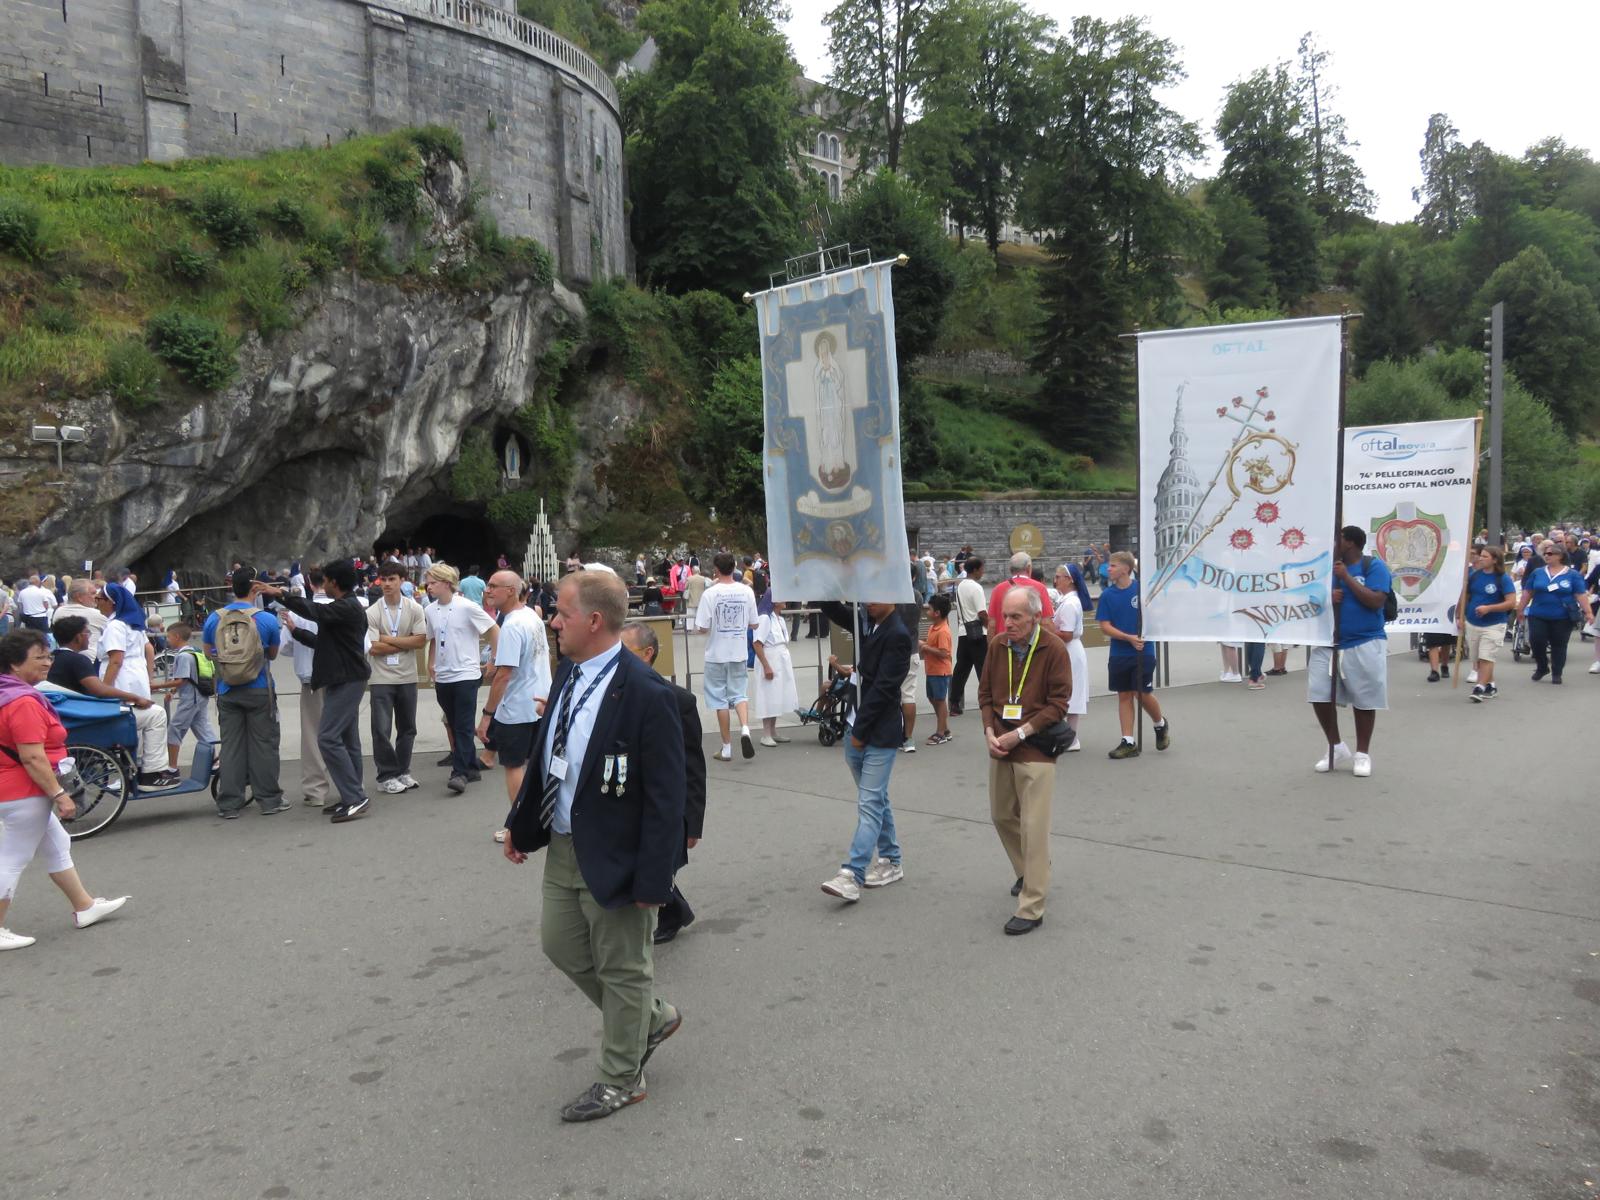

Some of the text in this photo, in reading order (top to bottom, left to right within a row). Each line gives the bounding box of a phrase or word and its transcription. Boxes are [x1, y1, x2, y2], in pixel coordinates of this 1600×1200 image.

[1212, 340, 1269, 355] OFTAL
[1375, 467, 1455, 478] PELLEGRINAGGIO
[1344, 478, 1472, 491] DIOCESANO OFTAL NOVARA
[1200, 563, 1316, 593] DIOCESI DI
[1398, 617, 1440, 625] GRAZIA
